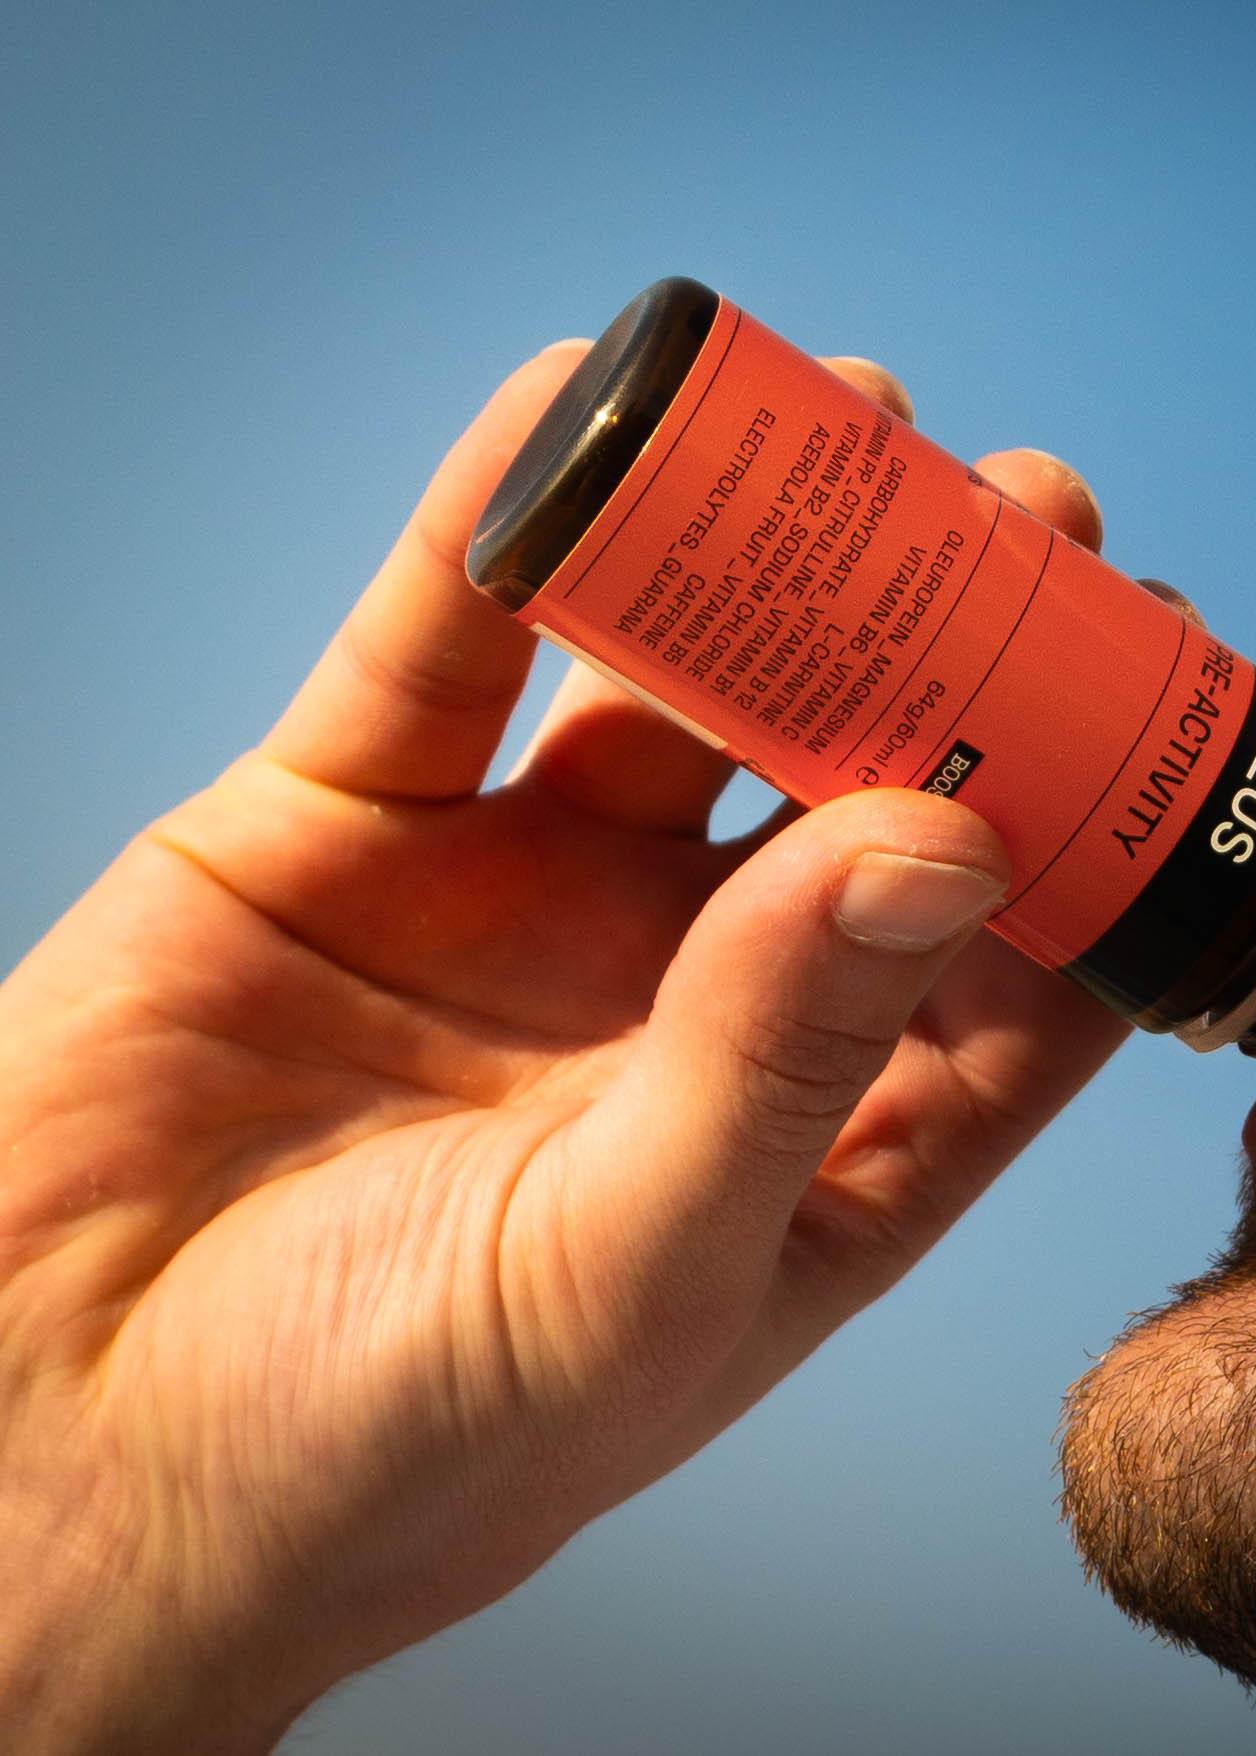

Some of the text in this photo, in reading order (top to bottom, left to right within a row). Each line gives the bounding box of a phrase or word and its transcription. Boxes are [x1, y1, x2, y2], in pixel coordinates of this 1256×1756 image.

[775, 422, 831, 505] ACEROLA
[820, 421, 863, 488] VITAMIN
[638, 573, 706, 650] CAFFEINE
[868, 546, 927, 625] VITAMIN
[662, 640, 689, 666] B5
[685, 601, 756, 682] CHLORIDE
[756, 623, 845, 727] L-CARNITINE
[709, 673, 735, 697] B1
[733, 692, 757, 711] 12
[749, 676, 769, 693] B
[781, 725, 800, 741] C
[872, 680, 946, 768] 64g/60ml
[1111, 645, 1234, 861] PRE-ACTIVITY
[924, 751, 973, 799] BOOS
